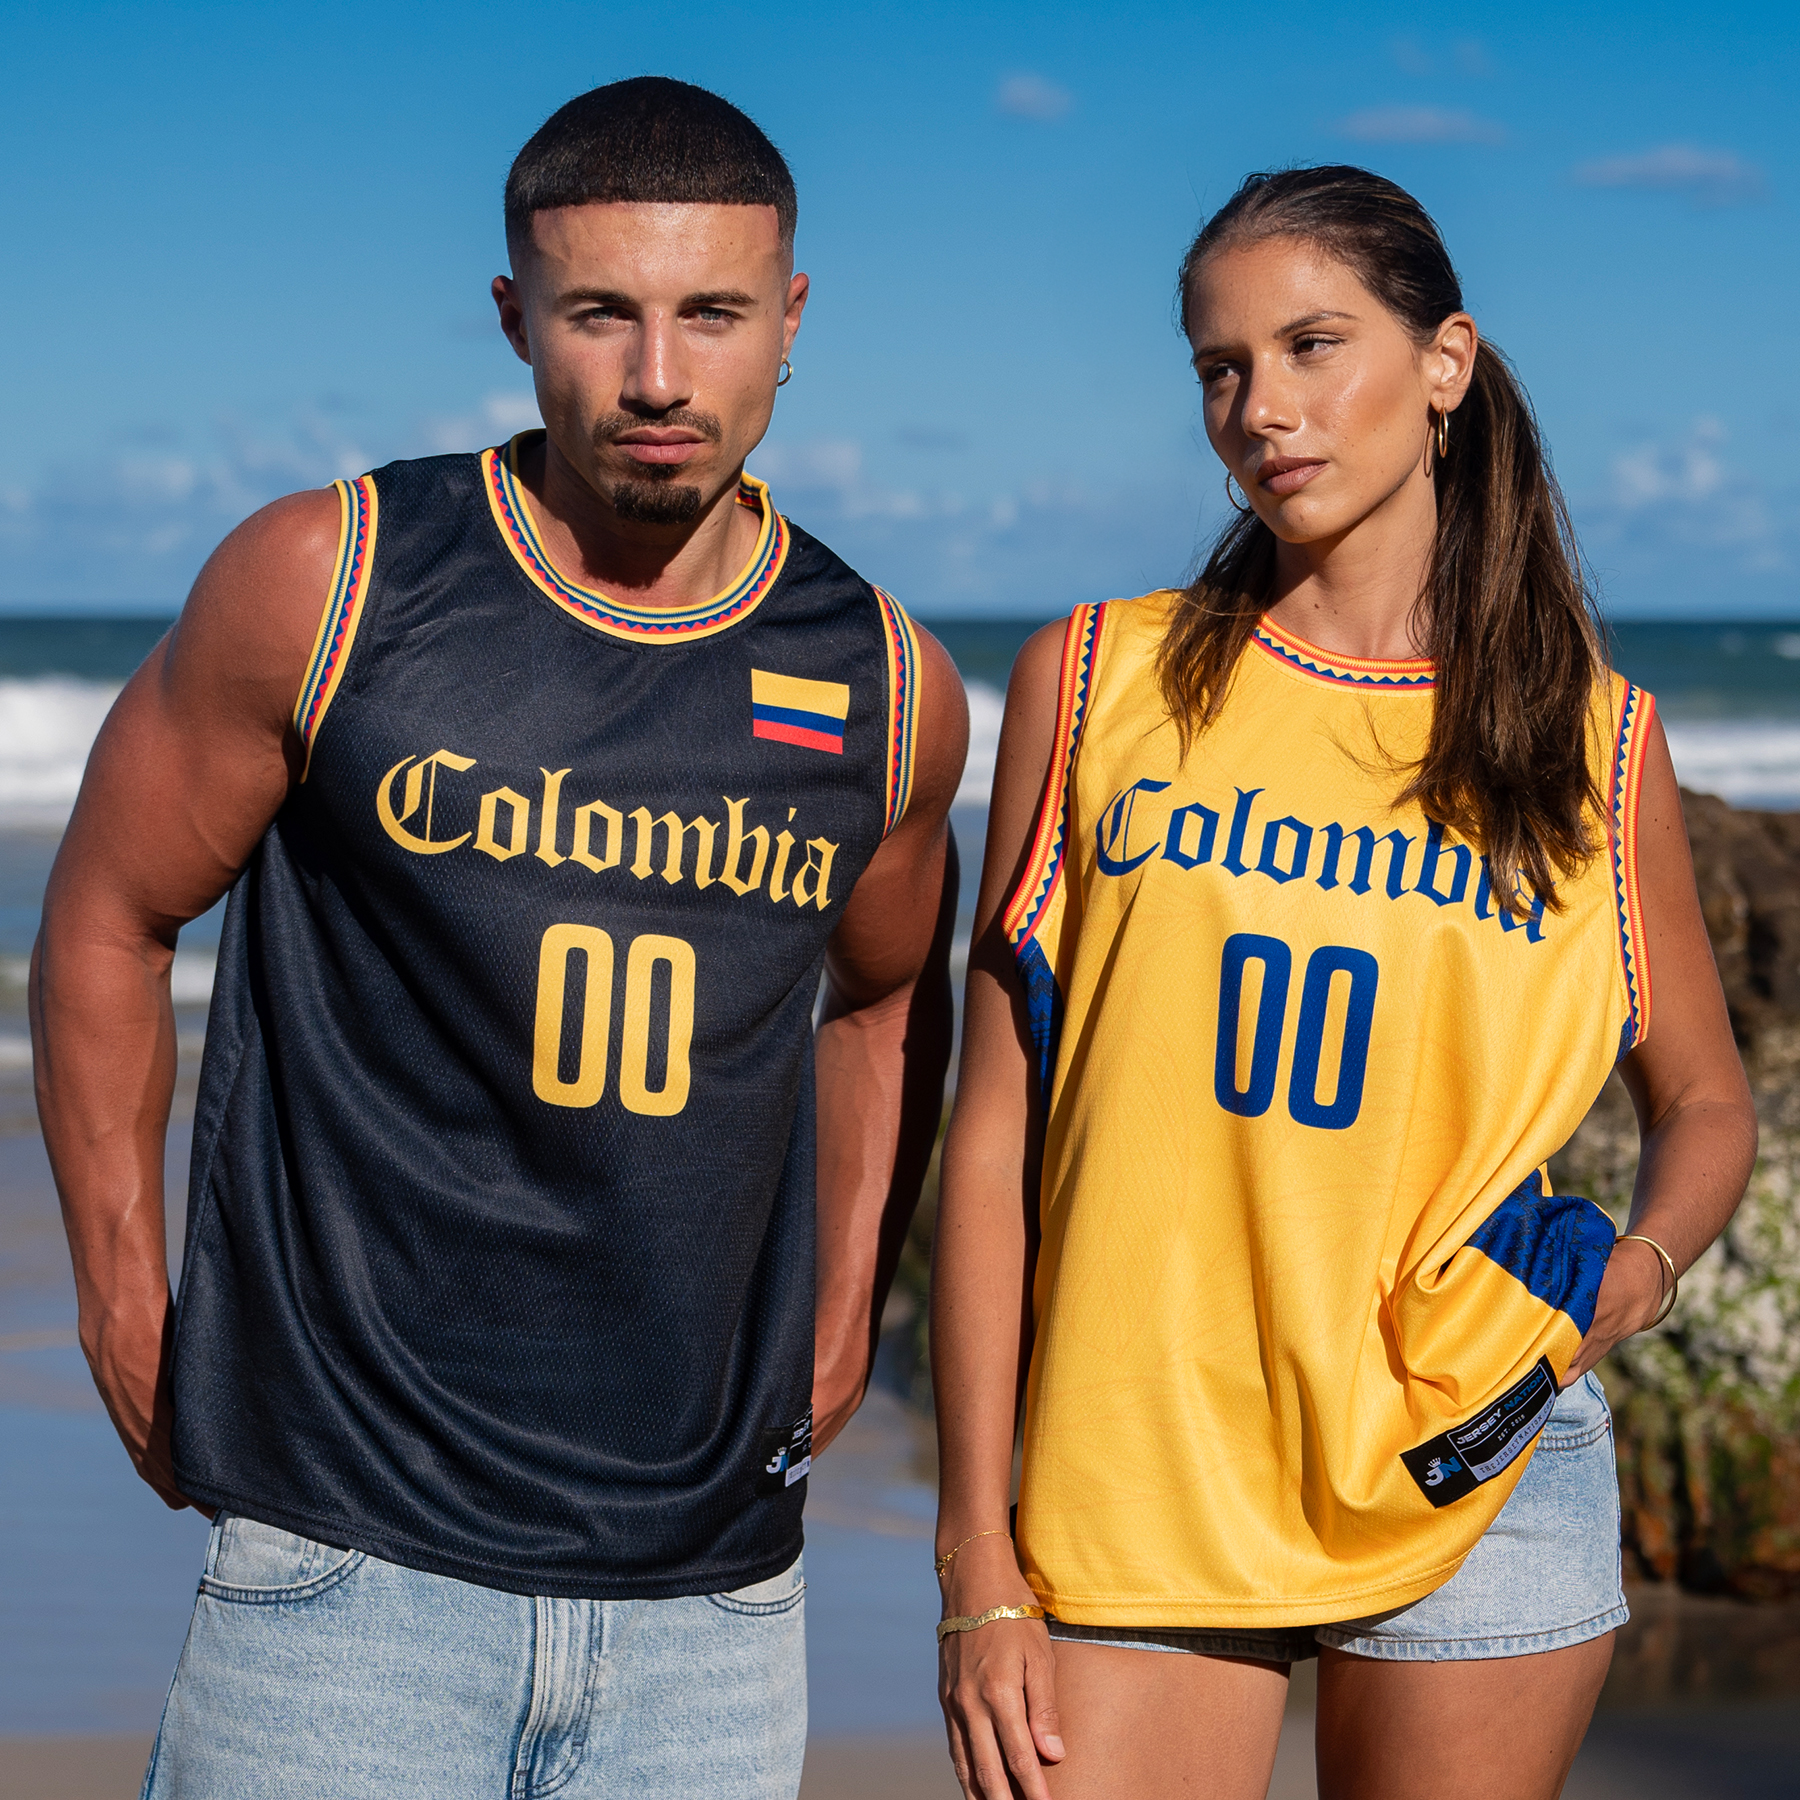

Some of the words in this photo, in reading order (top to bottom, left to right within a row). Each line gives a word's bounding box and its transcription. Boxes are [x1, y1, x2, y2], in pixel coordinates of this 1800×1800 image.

[376, 748, 840, 912] Colombia
[532, 922, 696, 1117] 00
[1213, 932, 1379, 1131] 00
[1424, 1455, 1463, 1488] JN
[1456, 1407, 1502, 1445] JERSEY
[1503, 1371, 1545, 1411] NATION
